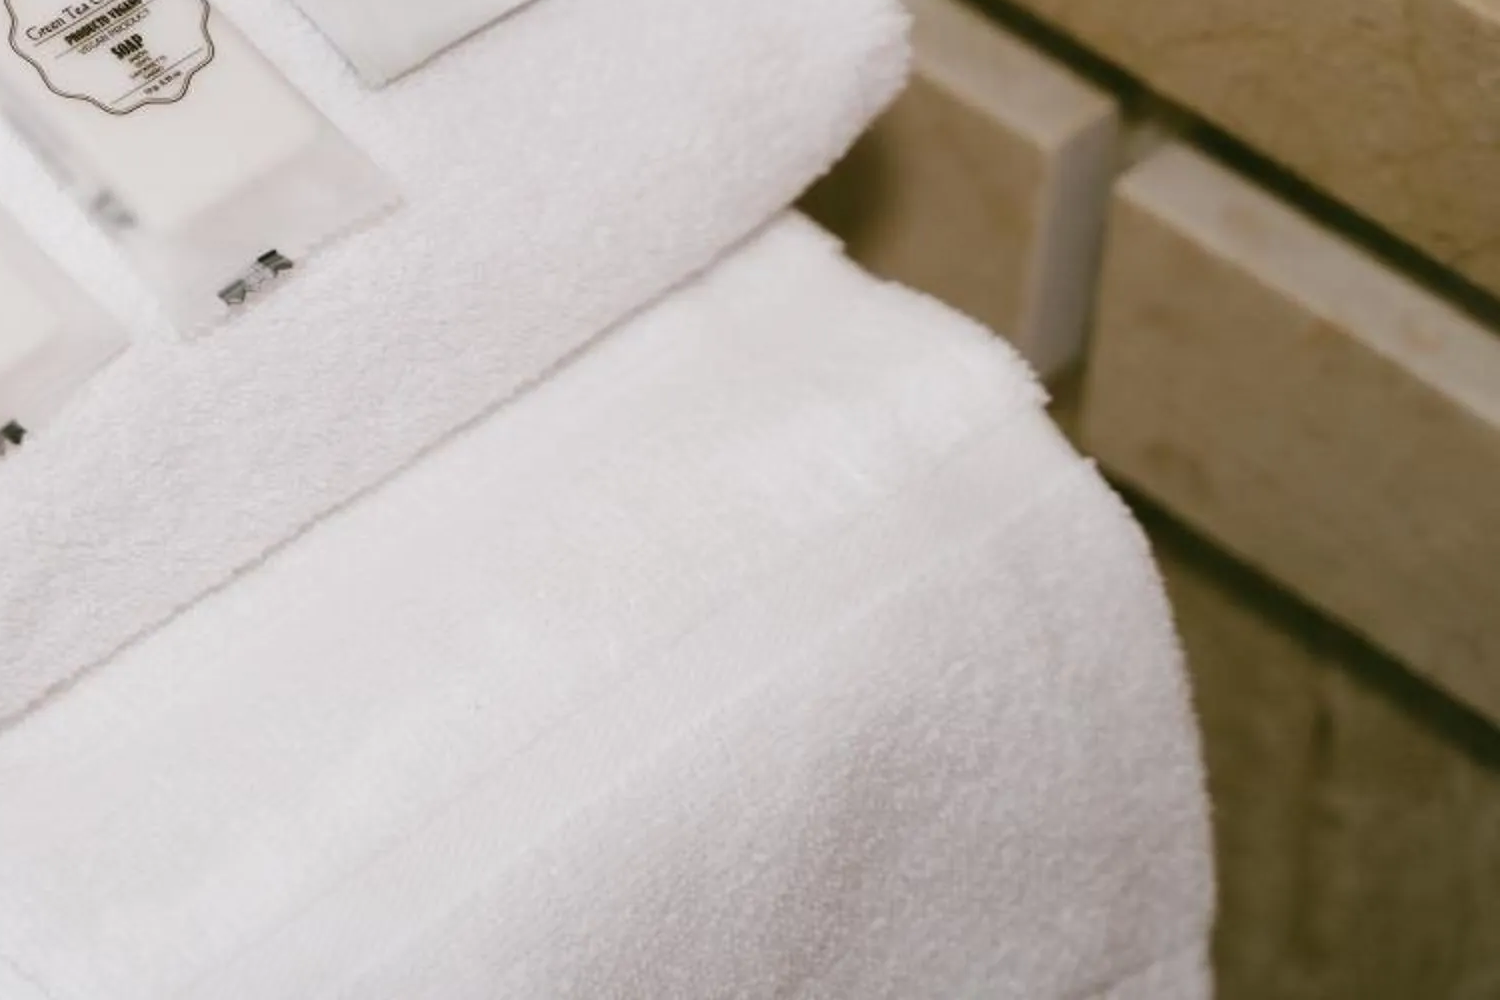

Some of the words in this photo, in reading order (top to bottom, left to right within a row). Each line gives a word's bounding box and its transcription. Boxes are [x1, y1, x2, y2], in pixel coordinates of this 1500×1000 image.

[25, 18, 64, 41] Green
[62, 1, 90, 18] Tea
[110, 33, 144, 61] SOAP
